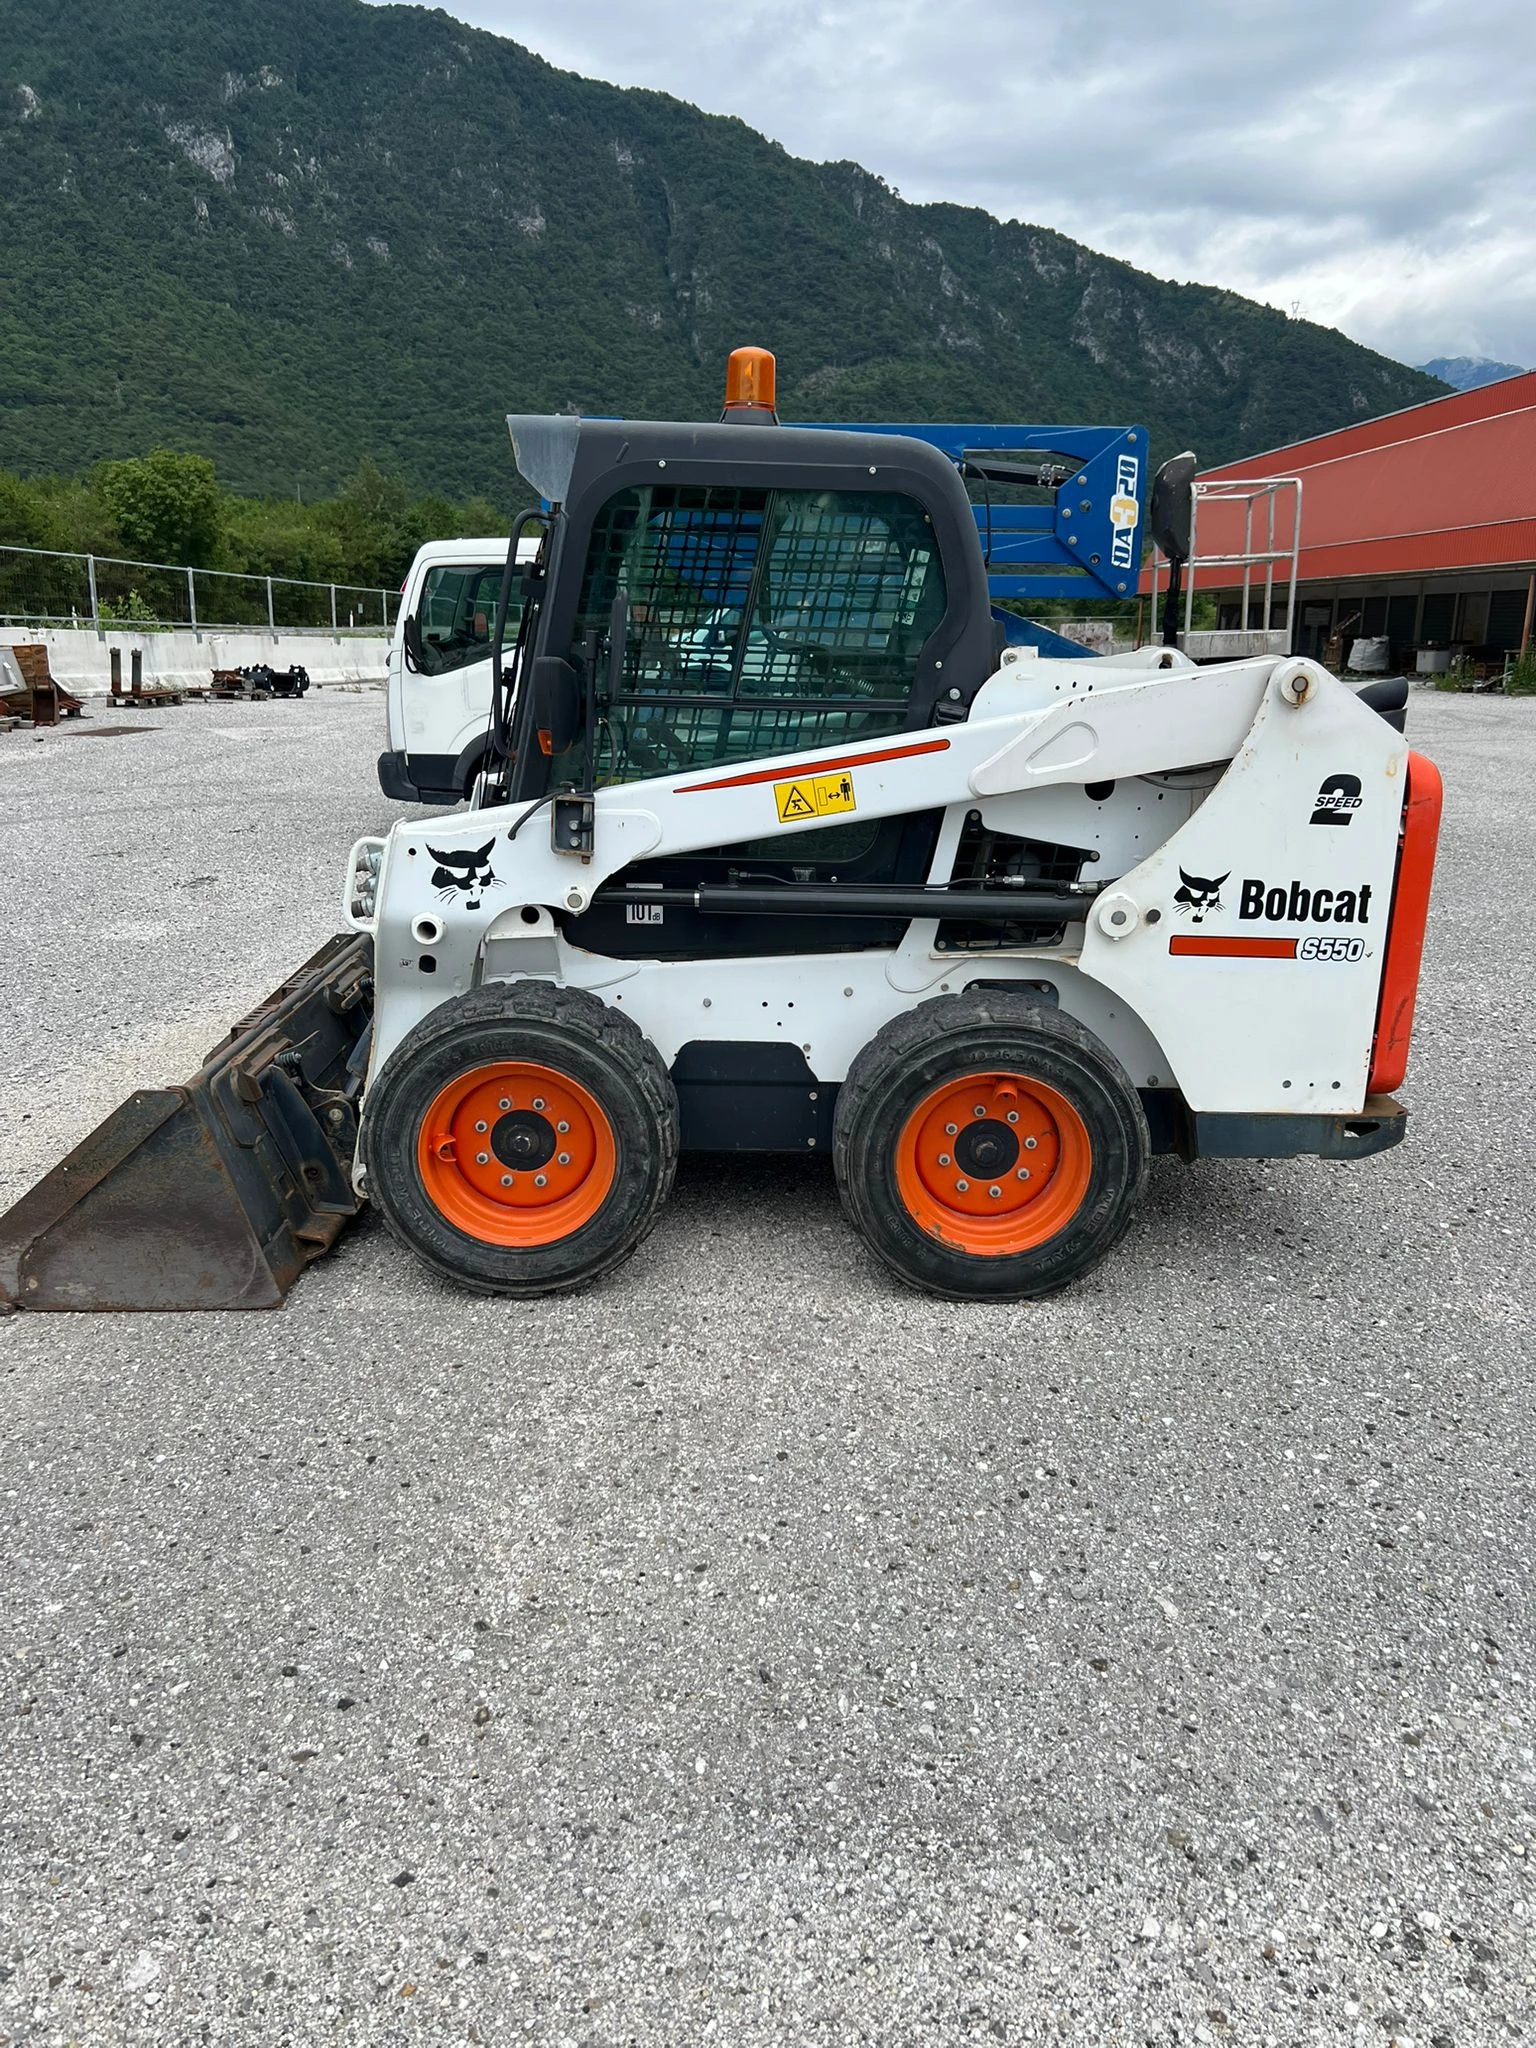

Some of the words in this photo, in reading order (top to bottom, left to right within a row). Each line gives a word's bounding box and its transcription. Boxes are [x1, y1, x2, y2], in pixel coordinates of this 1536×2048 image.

[1309, 774, 1362, 826] 2
[1314, 796, 1363, 808] SPEED
[1239, 879, 1372, 923] Bobcat
[1300, 936, 1366, 962] S550
